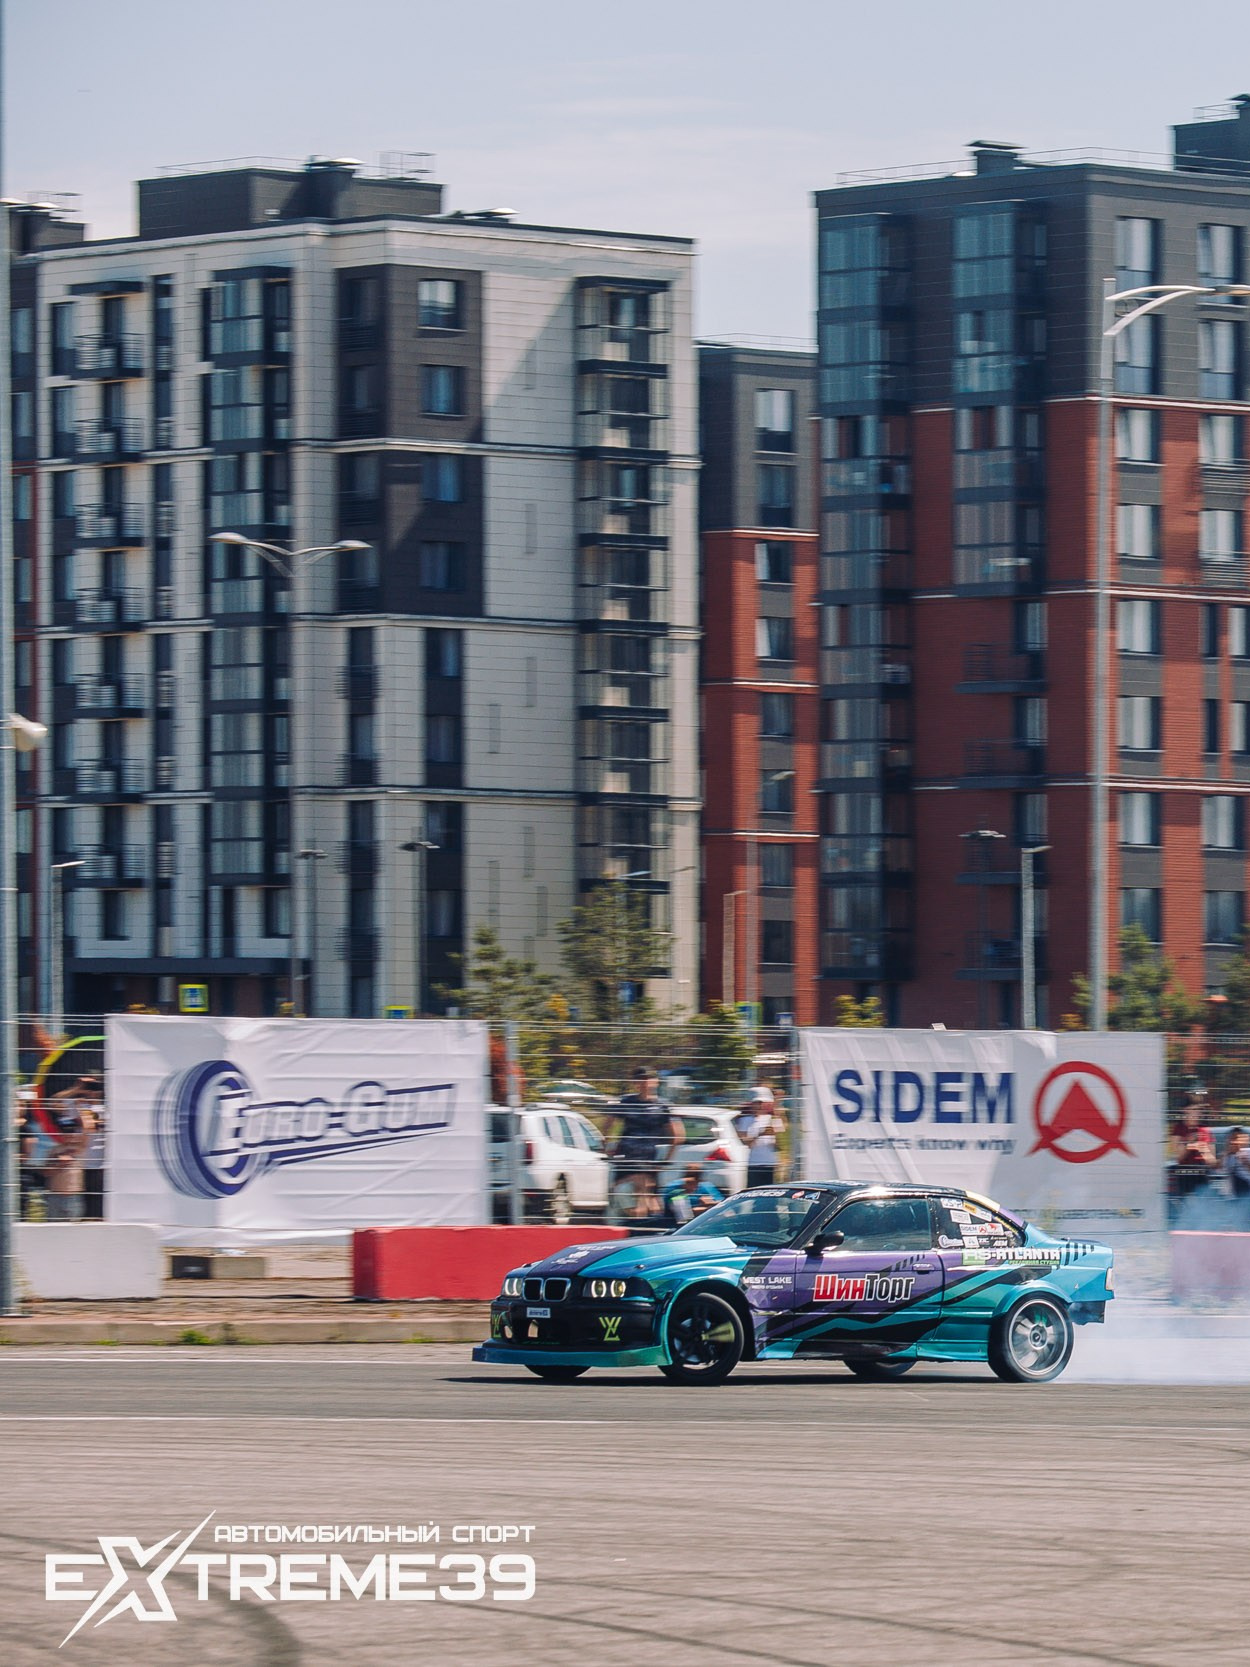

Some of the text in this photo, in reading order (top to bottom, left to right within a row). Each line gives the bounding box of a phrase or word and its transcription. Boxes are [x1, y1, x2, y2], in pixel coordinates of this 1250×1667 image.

[832, 1069, 1017, 1123] SIDEM
[742, 1276, 792, 1284] WEST LAKE
[813, 1274, 915, 1303] ШинТорг
